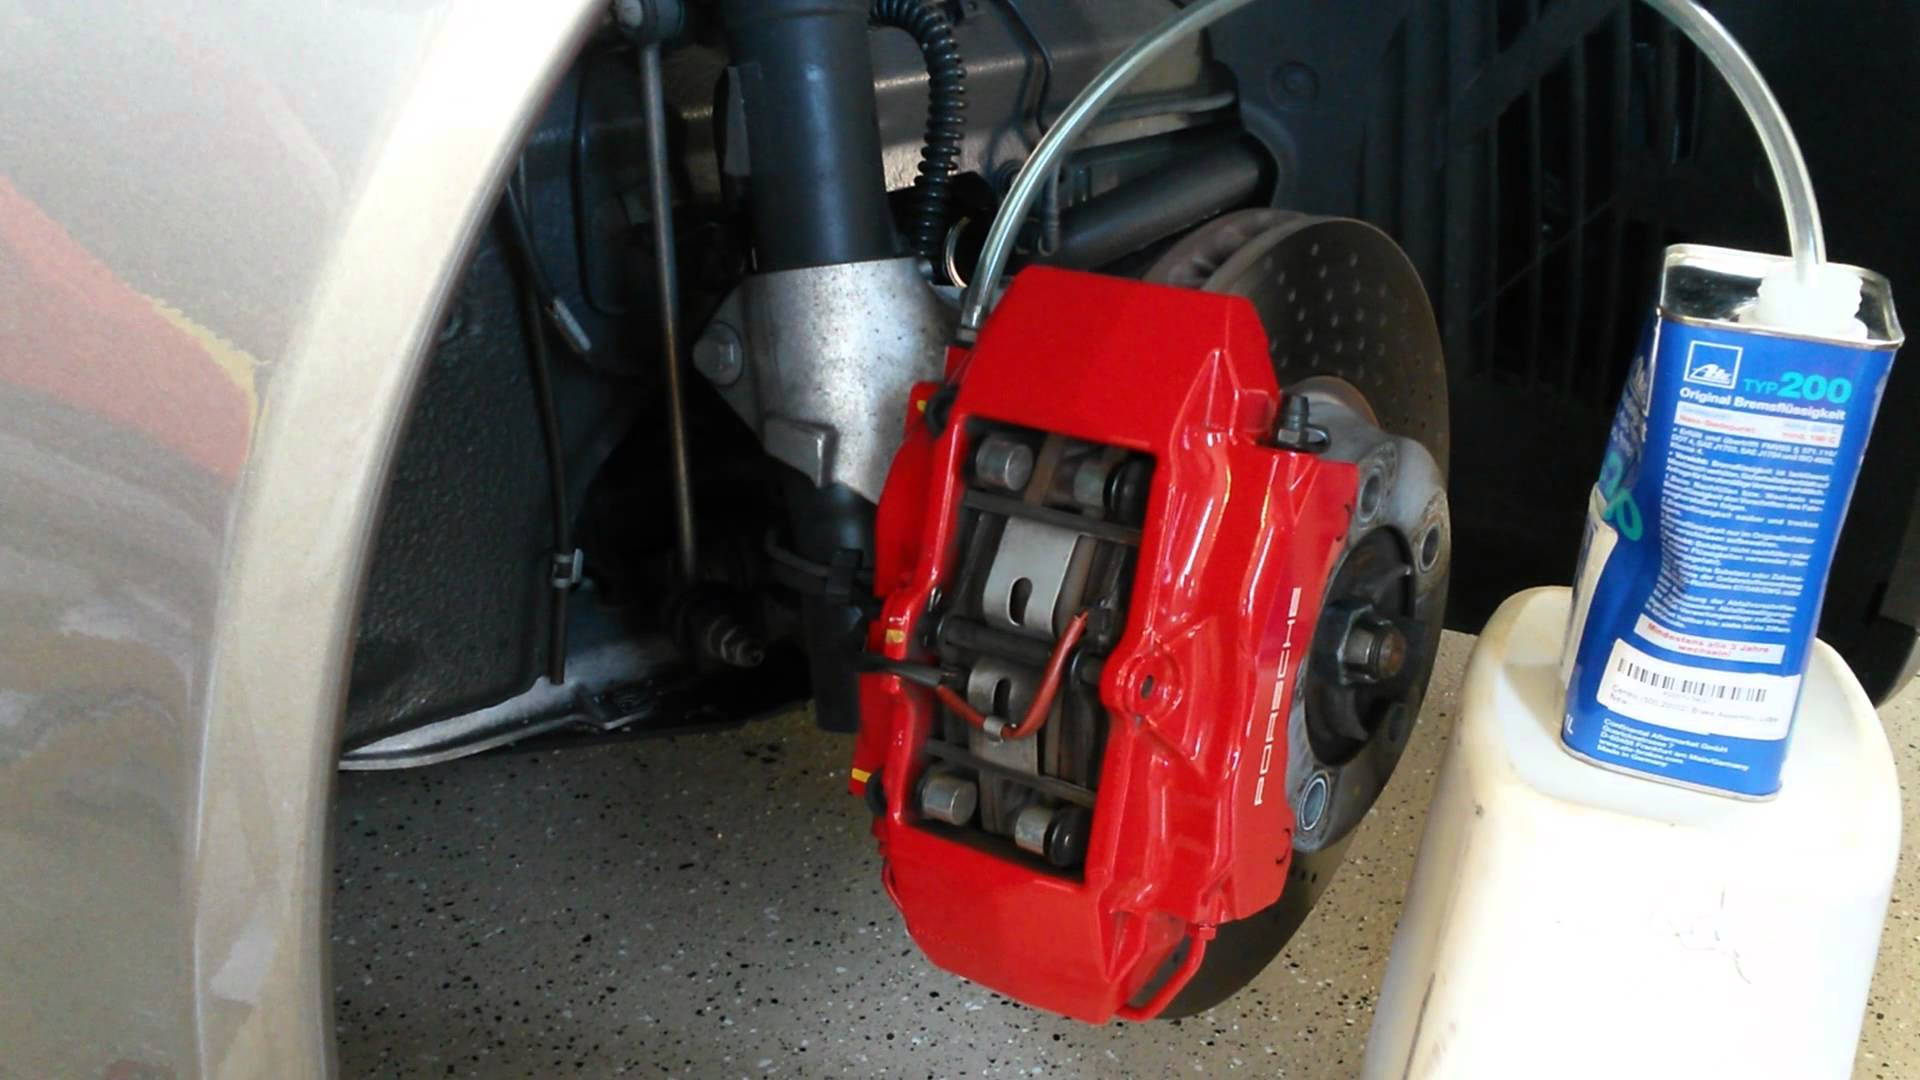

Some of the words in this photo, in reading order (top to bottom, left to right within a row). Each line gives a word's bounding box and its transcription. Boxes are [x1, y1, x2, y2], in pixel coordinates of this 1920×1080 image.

[1680, 387, 1731, 405] Original
[1734, 396, 1846, 420] Bremsflüssigkeit
[1743, 378, 1778, 395] TYP
[1777, 371, 1852, 404] 200
[1254, 587, 1302, 806] PORSCHE
